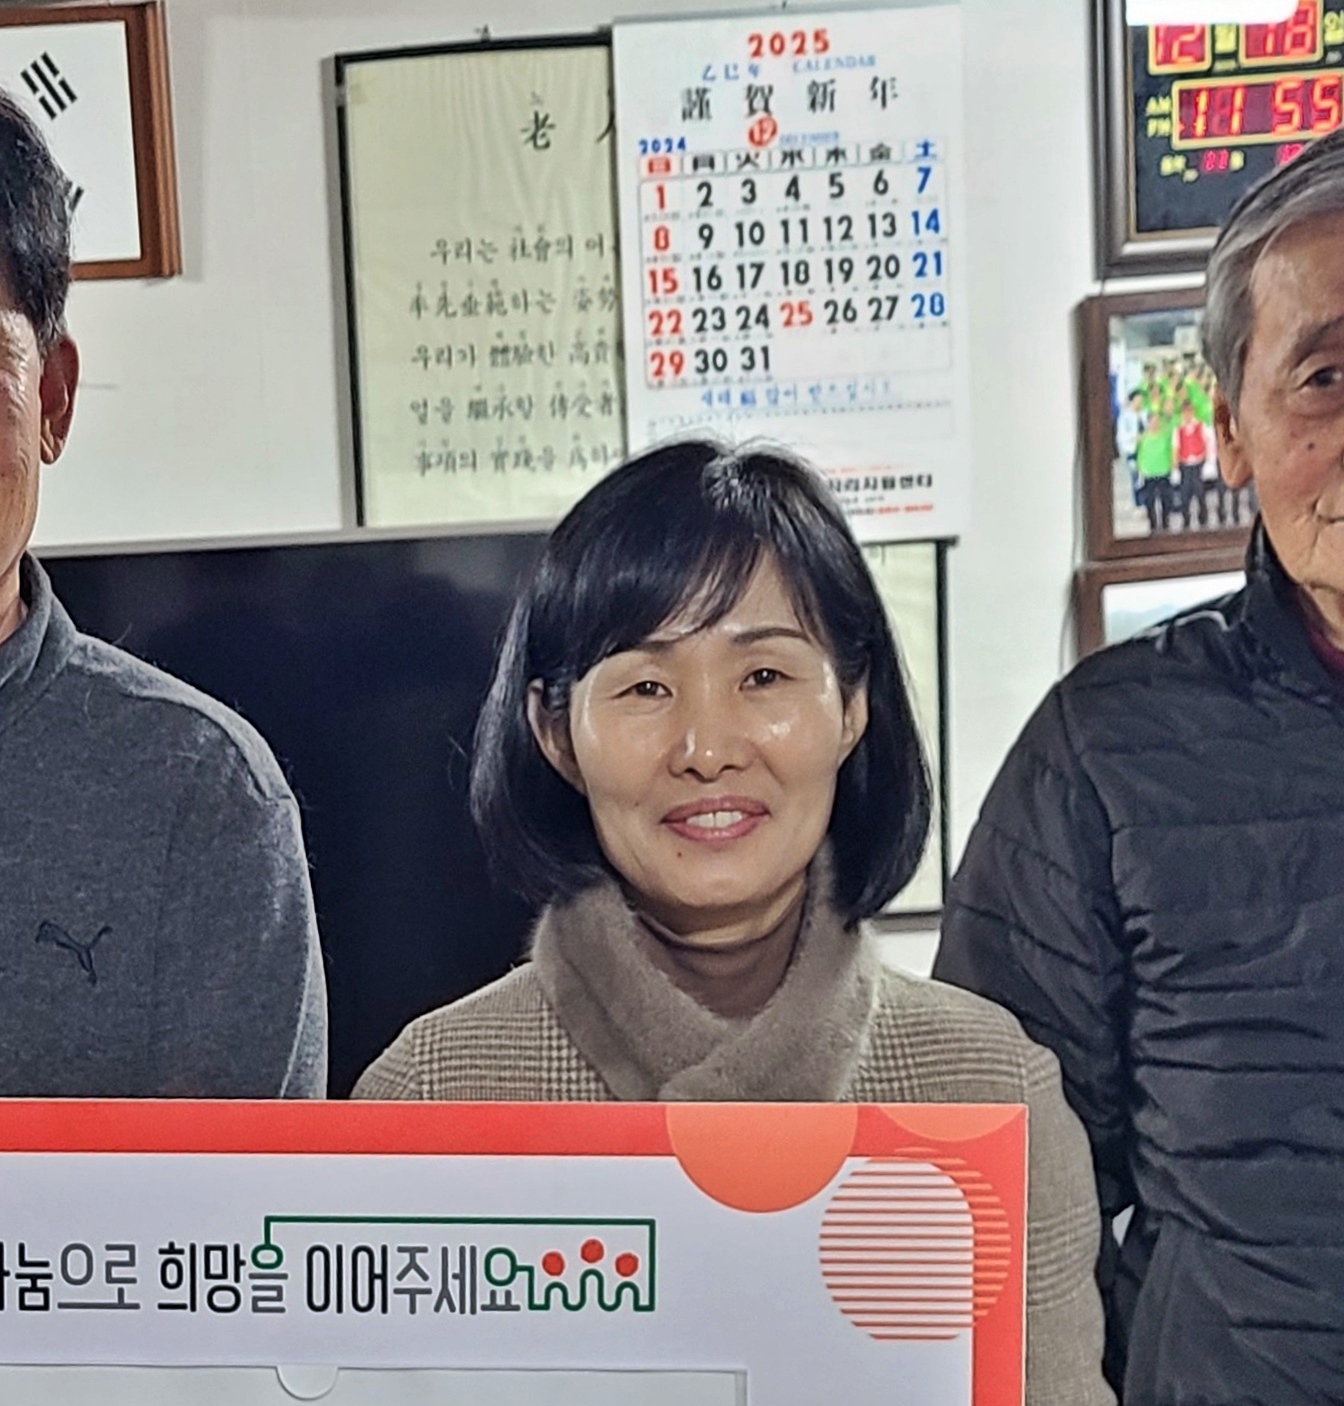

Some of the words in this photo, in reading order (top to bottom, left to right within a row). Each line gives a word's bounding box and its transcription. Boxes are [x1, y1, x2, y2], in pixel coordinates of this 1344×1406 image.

[748, 28, 830, 57] 2025
[792, 56, 876, 75] CALENDAR
[1271, 74, 1343, 136] 55
[638, 137, 687, 154] 2024
[914, 140, 937, 159] 土
[741, 178, 756, 204] 3
[785, 175, 801, 204] 4
[829, 172, 844, 199] 5
[874, 169, 889, 195] 6
[916, 167, 932, 194] 7
[655, 185, 666, 209] 1
[697, 182, 713, 208] 2
[735, 221, 765, 248] 10
[781, 217, 809, 244] 11
[824, 215, 853, 242] 12
[868, 212, 897, 239] 13
[912, 208, 941, 236] 14
[655, 223, 669, 251] 8
[698, 223, 714, 249] 9
[431, 236, 498, 266] 우리는
[912, 251, 942, 278] 21
[648, 268, 678, 294] 15
[693, 265, 722, 292] 16
[736, 262, 765, 289] 17
[781, 260, 810, 287] 18
[825, 257, 854, 284] 19
[867, 254, 900, 281] 20
[736, 303, 770, 330] 24
[780, 300, 813, 328] 25
[824, 298, 857, 324] 26
[868, 295, 899, 322] 27
[911, 292, 945, 318] 28
[648, 309, 683, 336] 22
[692, 306, 726, 334] 23
[412, 342, 476, 370] 우리가
[650, 351, 684, 378] 29
[694, 348, 728, 375] 30
[741, 345, 770, 372] 31
[157, 1241, 289, 1314] 희망을
[306, 1243, 522, 1316] 이어주세요
